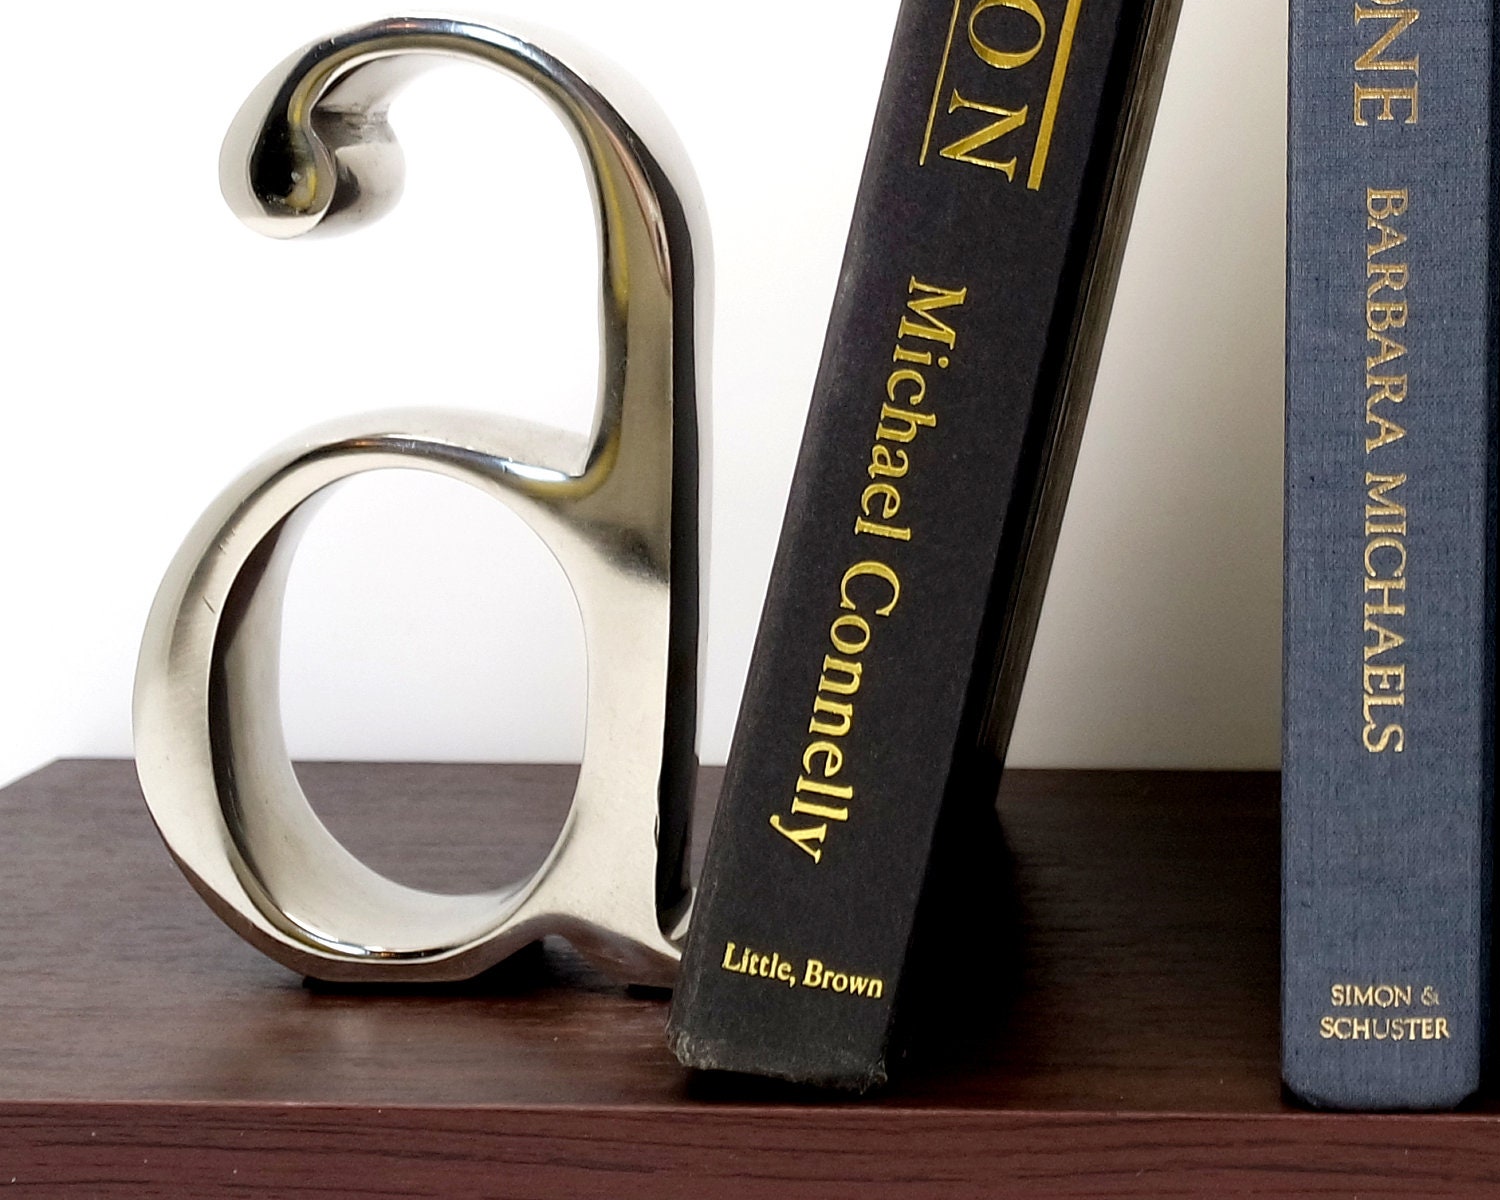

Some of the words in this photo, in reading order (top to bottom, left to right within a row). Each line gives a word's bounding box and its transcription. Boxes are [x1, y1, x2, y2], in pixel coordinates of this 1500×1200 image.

[853, 275, 967, 544] Michael
[1365, 187, 1409, 454] BARBARA
[770, 559, 902, 865] Connelly
[1363, 472, 1408, 754] MICHAELS
[721, 941, 797, 988] Little,
[801, 957, 885, 999] Brown
[1319, 1016, 1451, 1041] SCHUSTER
[1330, 984, 1412, 1007] SIMON
[1421, 984, 1440, 1007] &
